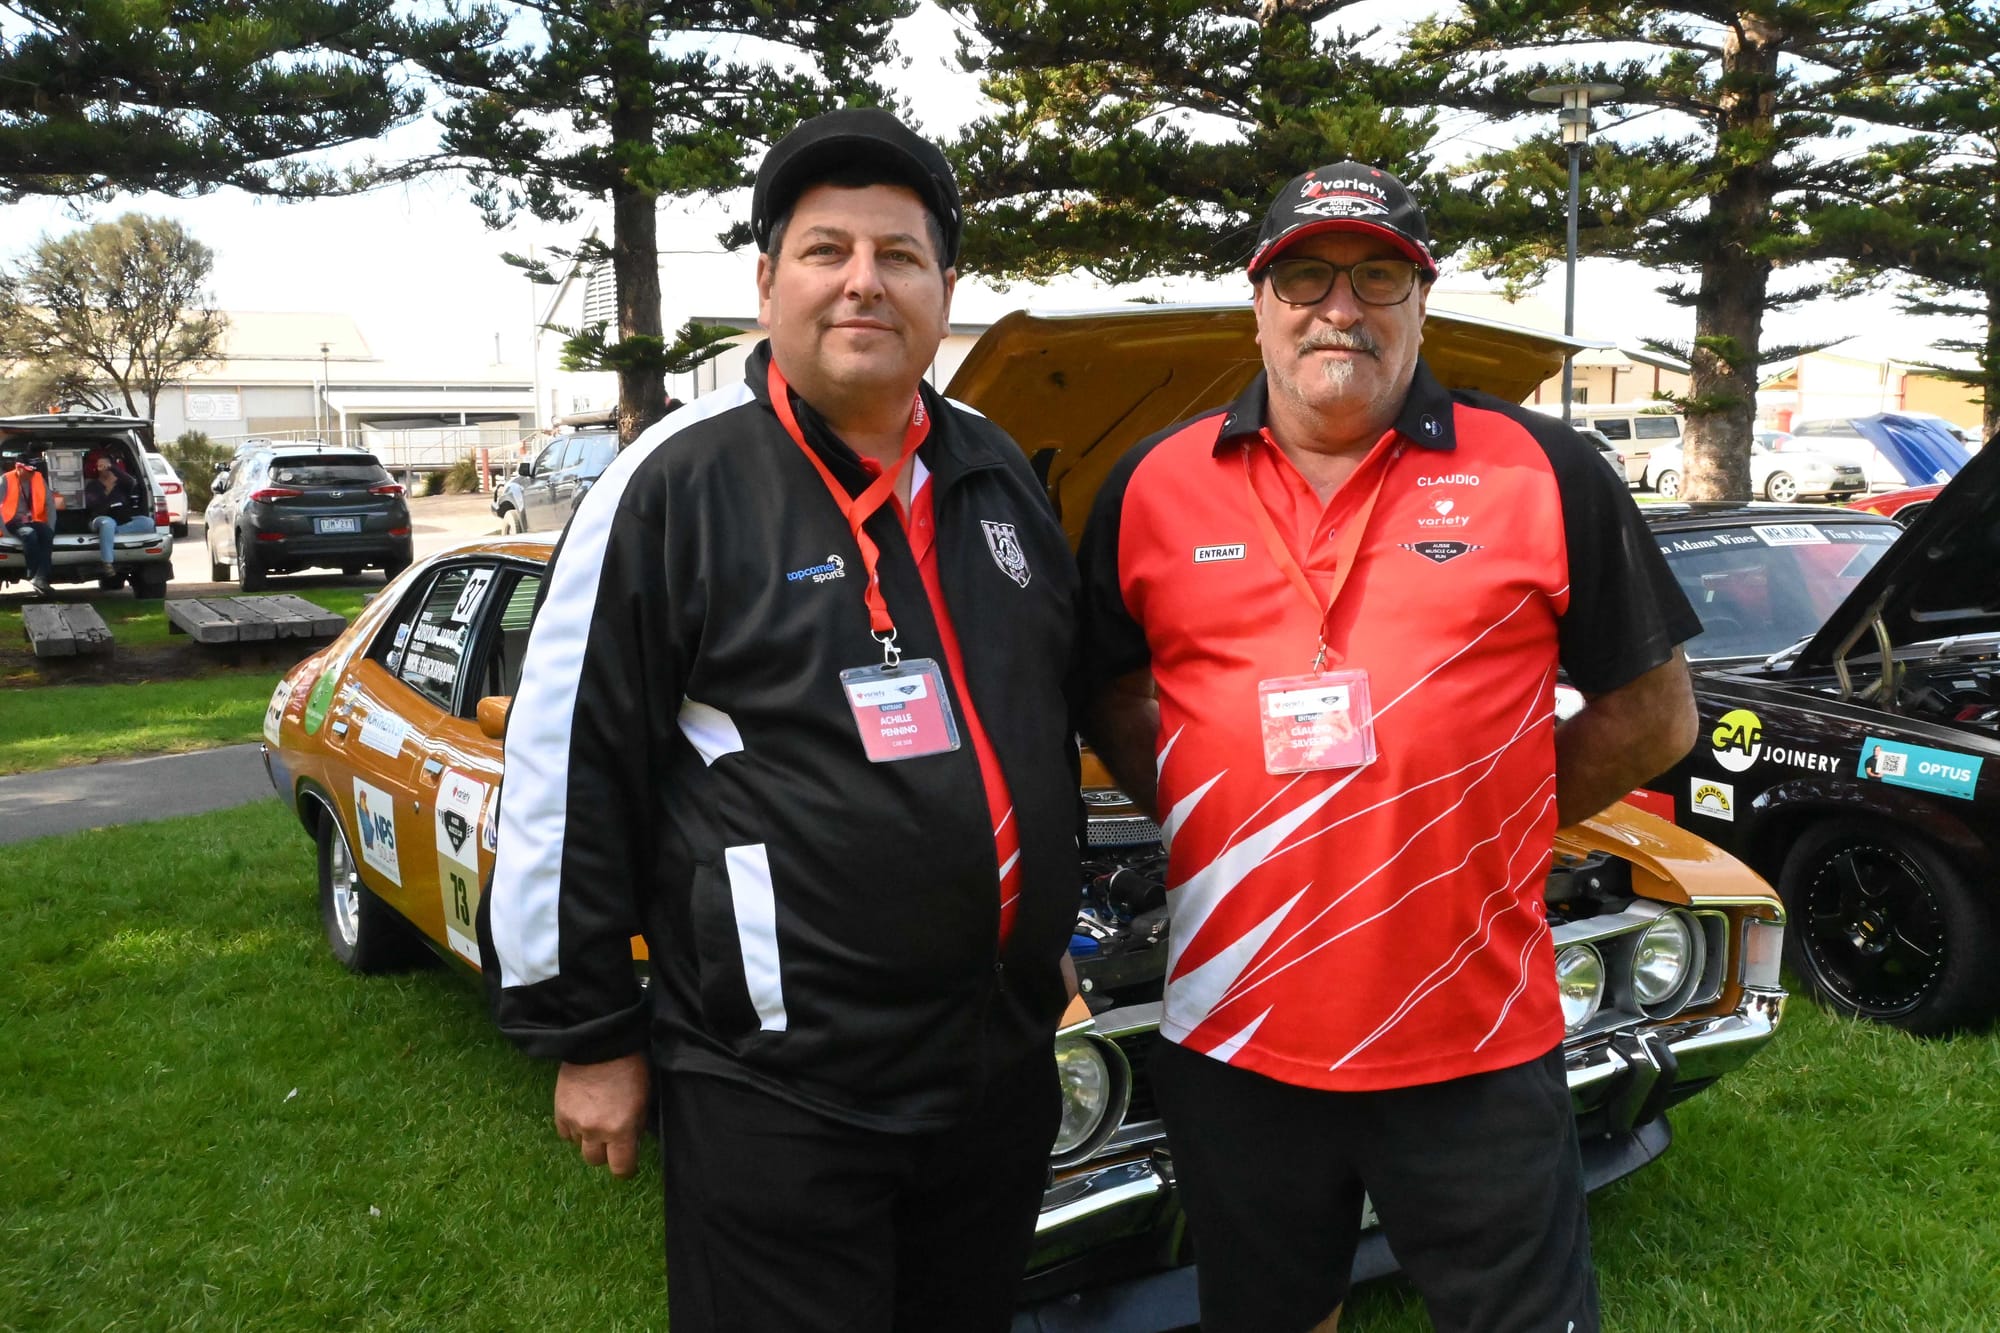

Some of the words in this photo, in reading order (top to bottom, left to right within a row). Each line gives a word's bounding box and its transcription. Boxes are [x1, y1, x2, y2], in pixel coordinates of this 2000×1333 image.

[1417, 474, 1480, 487] CLAUDIO
[1418, 515, 1470, 527] variety
[1672, 540, 1718, 552] Adams
[1713, 534, 1758, 545] Wines
[1199, 547, 1241, 559] ENTRANT
[812, 570, 845, 583] sports
[457, 578, 488, 616] 37
[880, 713, 912, 726] ACHILLE
[880, 725, 918, 737] PENNINO
[1762, 746, 1841, 774] JOINERY
[1917, 761, 1972, 782] OPTUS
[1696, 787, 1726, 805] BIANCO
[374, 811, 394, 850] NPS
[450, 872, 470, 927] 73
